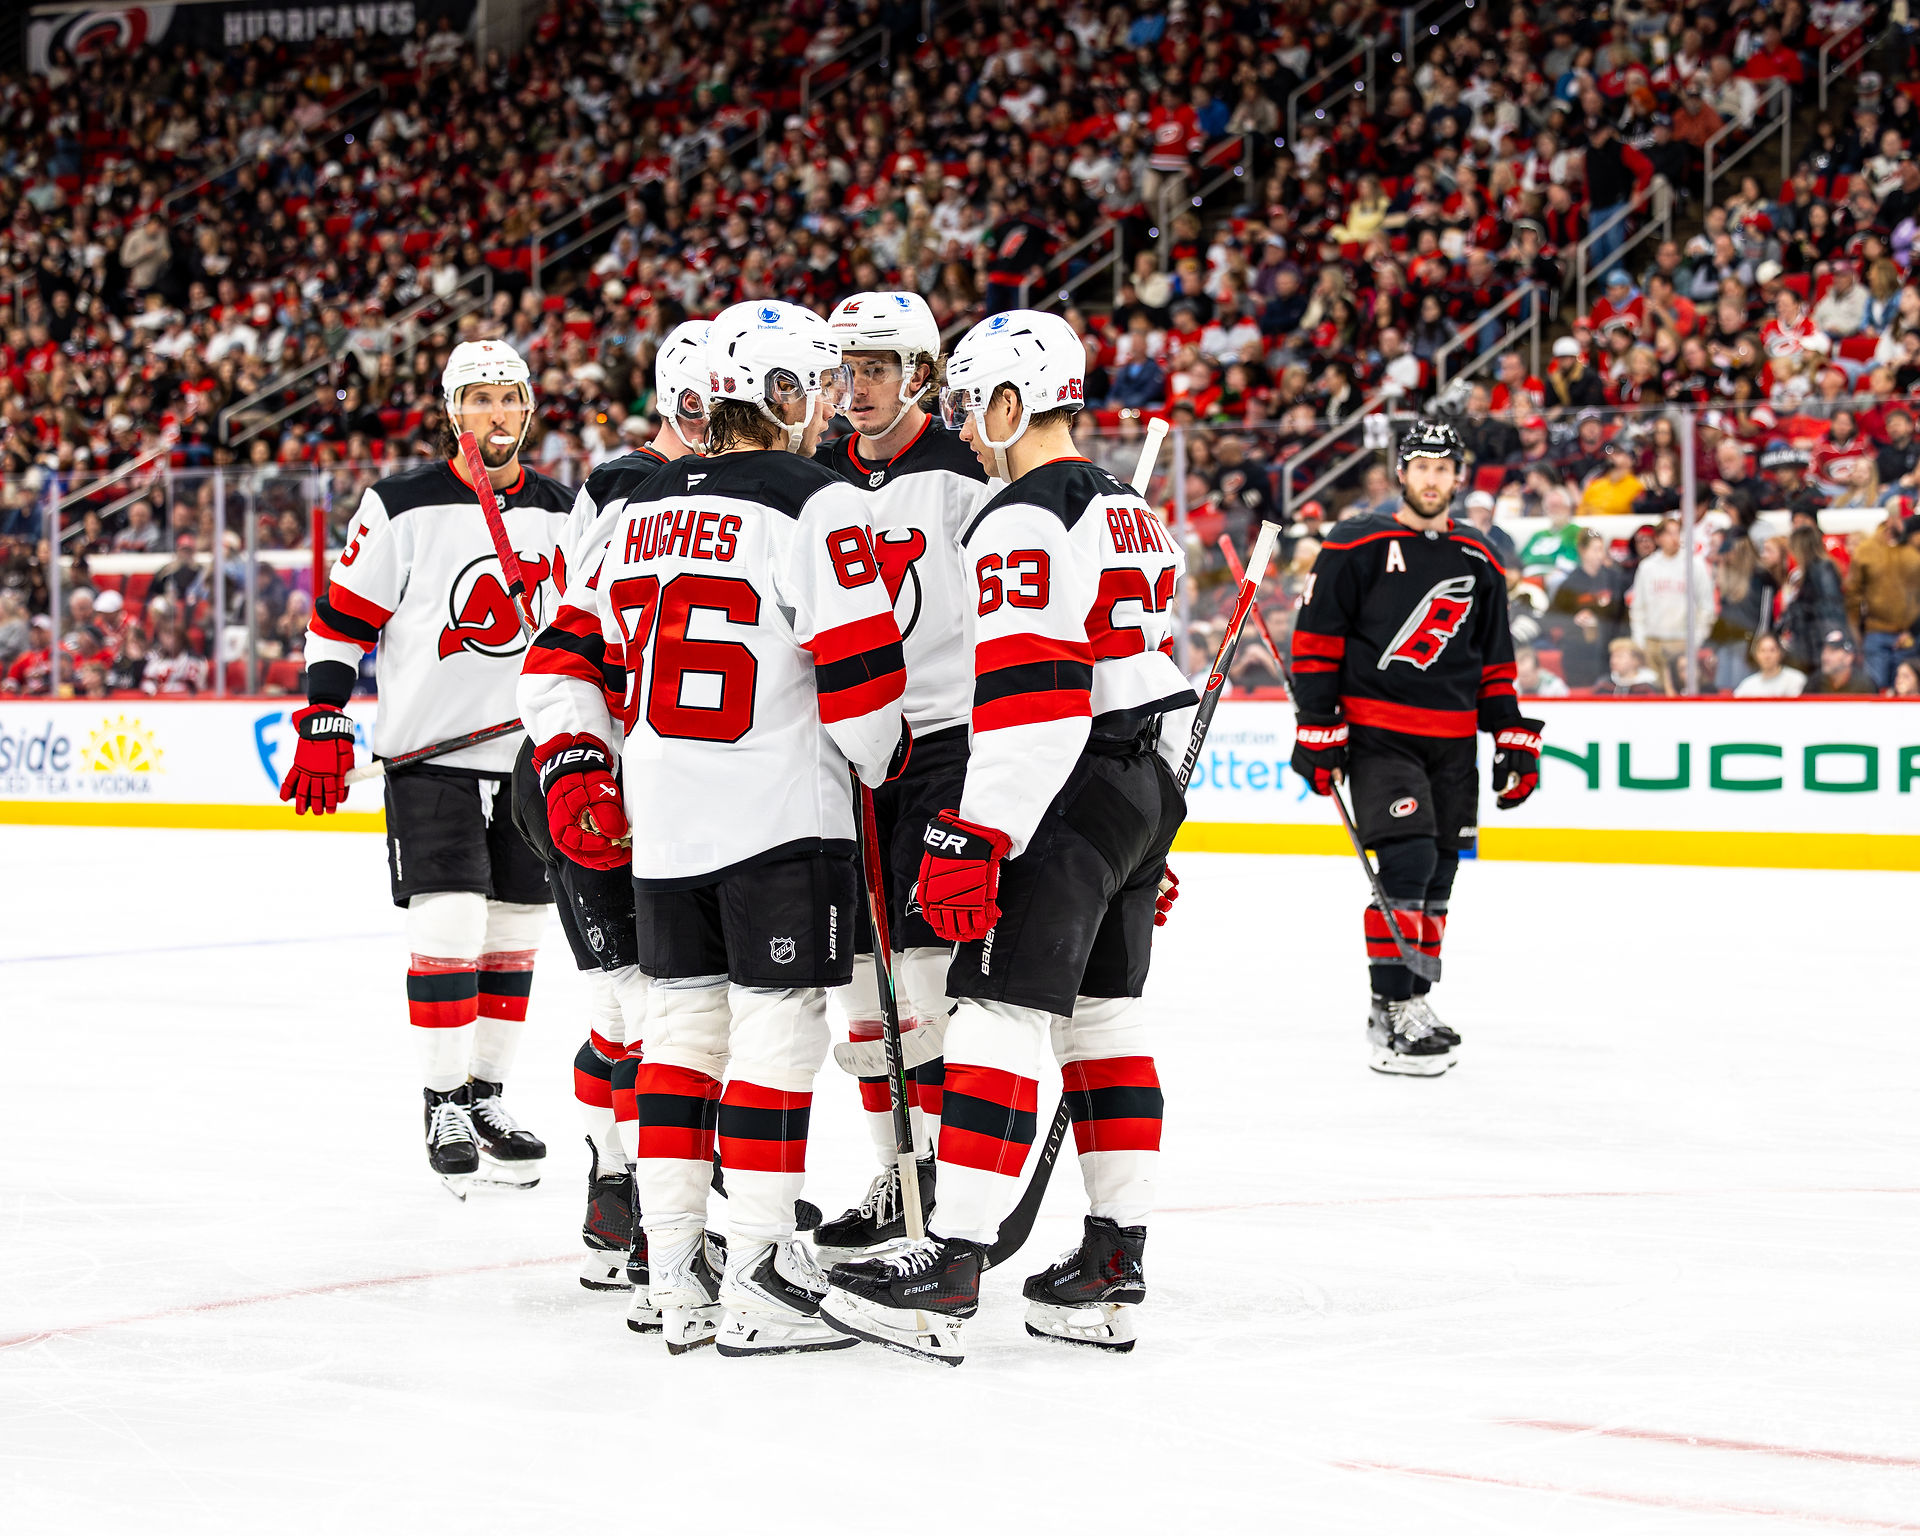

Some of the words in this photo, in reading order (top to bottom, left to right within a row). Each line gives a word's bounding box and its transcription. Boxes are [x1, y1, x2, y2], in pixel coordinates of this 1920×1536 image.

[223, 2, 416, 46] HURRICANES
[1069, 378, 1083, 400] 63
[340, 523, 369, 568] 5
[624, 509, 743, 565] HUGHES
[825, 524, 878, 590] 8
[1386, 540, 1407, 573] A
[975, 548, 1051, 618] 63
[1177, 719, 1207, 791] AUER
[829, 904, 838, 961] BAUER
[881, 1009, 899, 1094] BAUER
[904, 1281, 939, 1297] BAUER
[1054, 1269, 1081, 1287] BAUER
